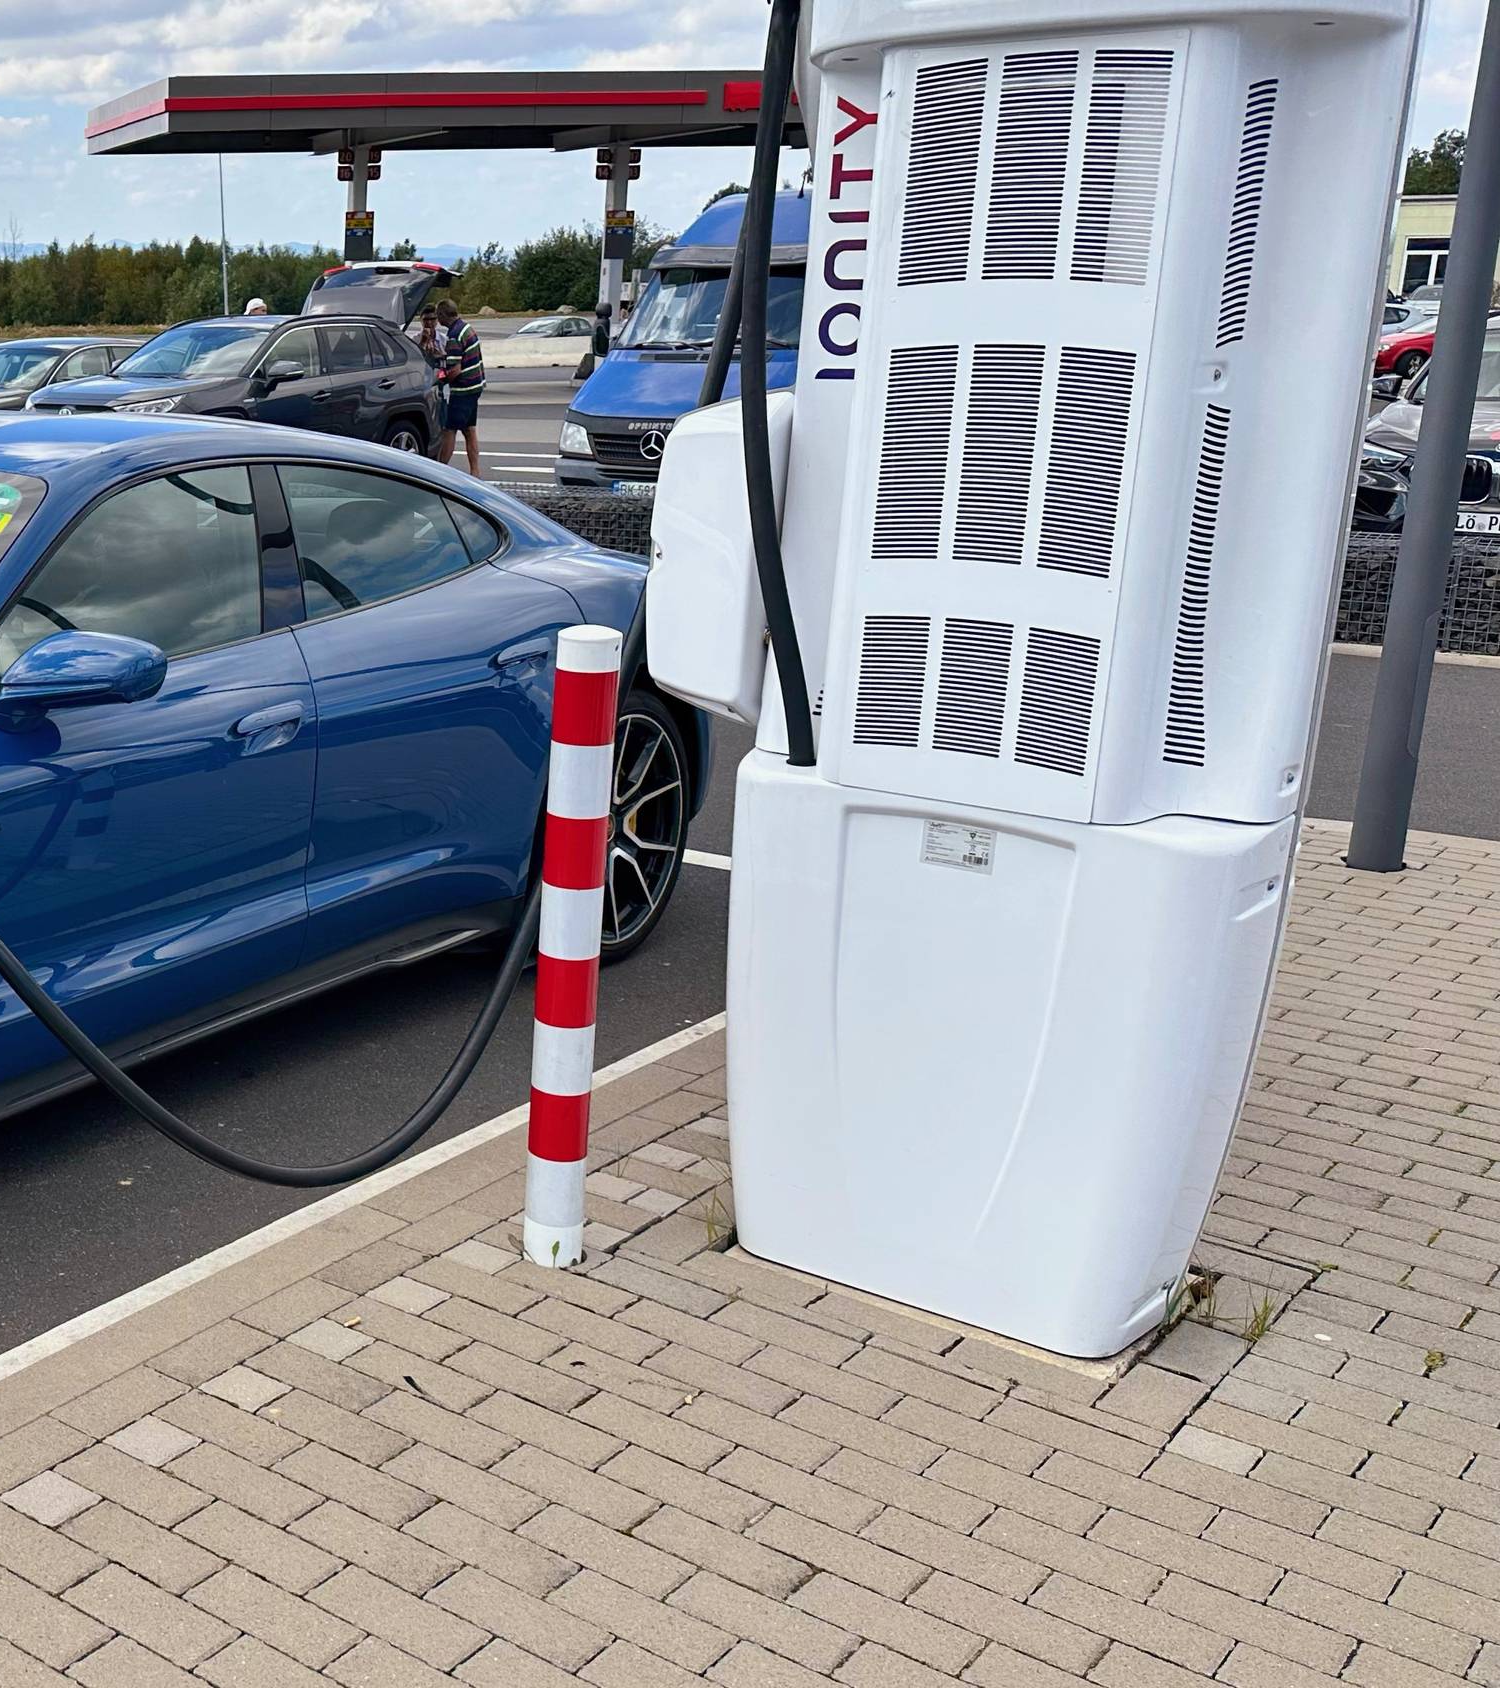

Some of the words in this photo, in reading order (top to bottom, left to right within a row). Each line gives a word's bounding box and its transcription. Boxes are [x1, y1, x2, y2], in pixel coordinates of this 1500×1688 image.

[815, 96, 879, 379] IONITY
[628, 422, 674, 431] SPRINTE
[1455, 514, 1476, 530] LÖ
[1489, 515, 1500, 531] P
